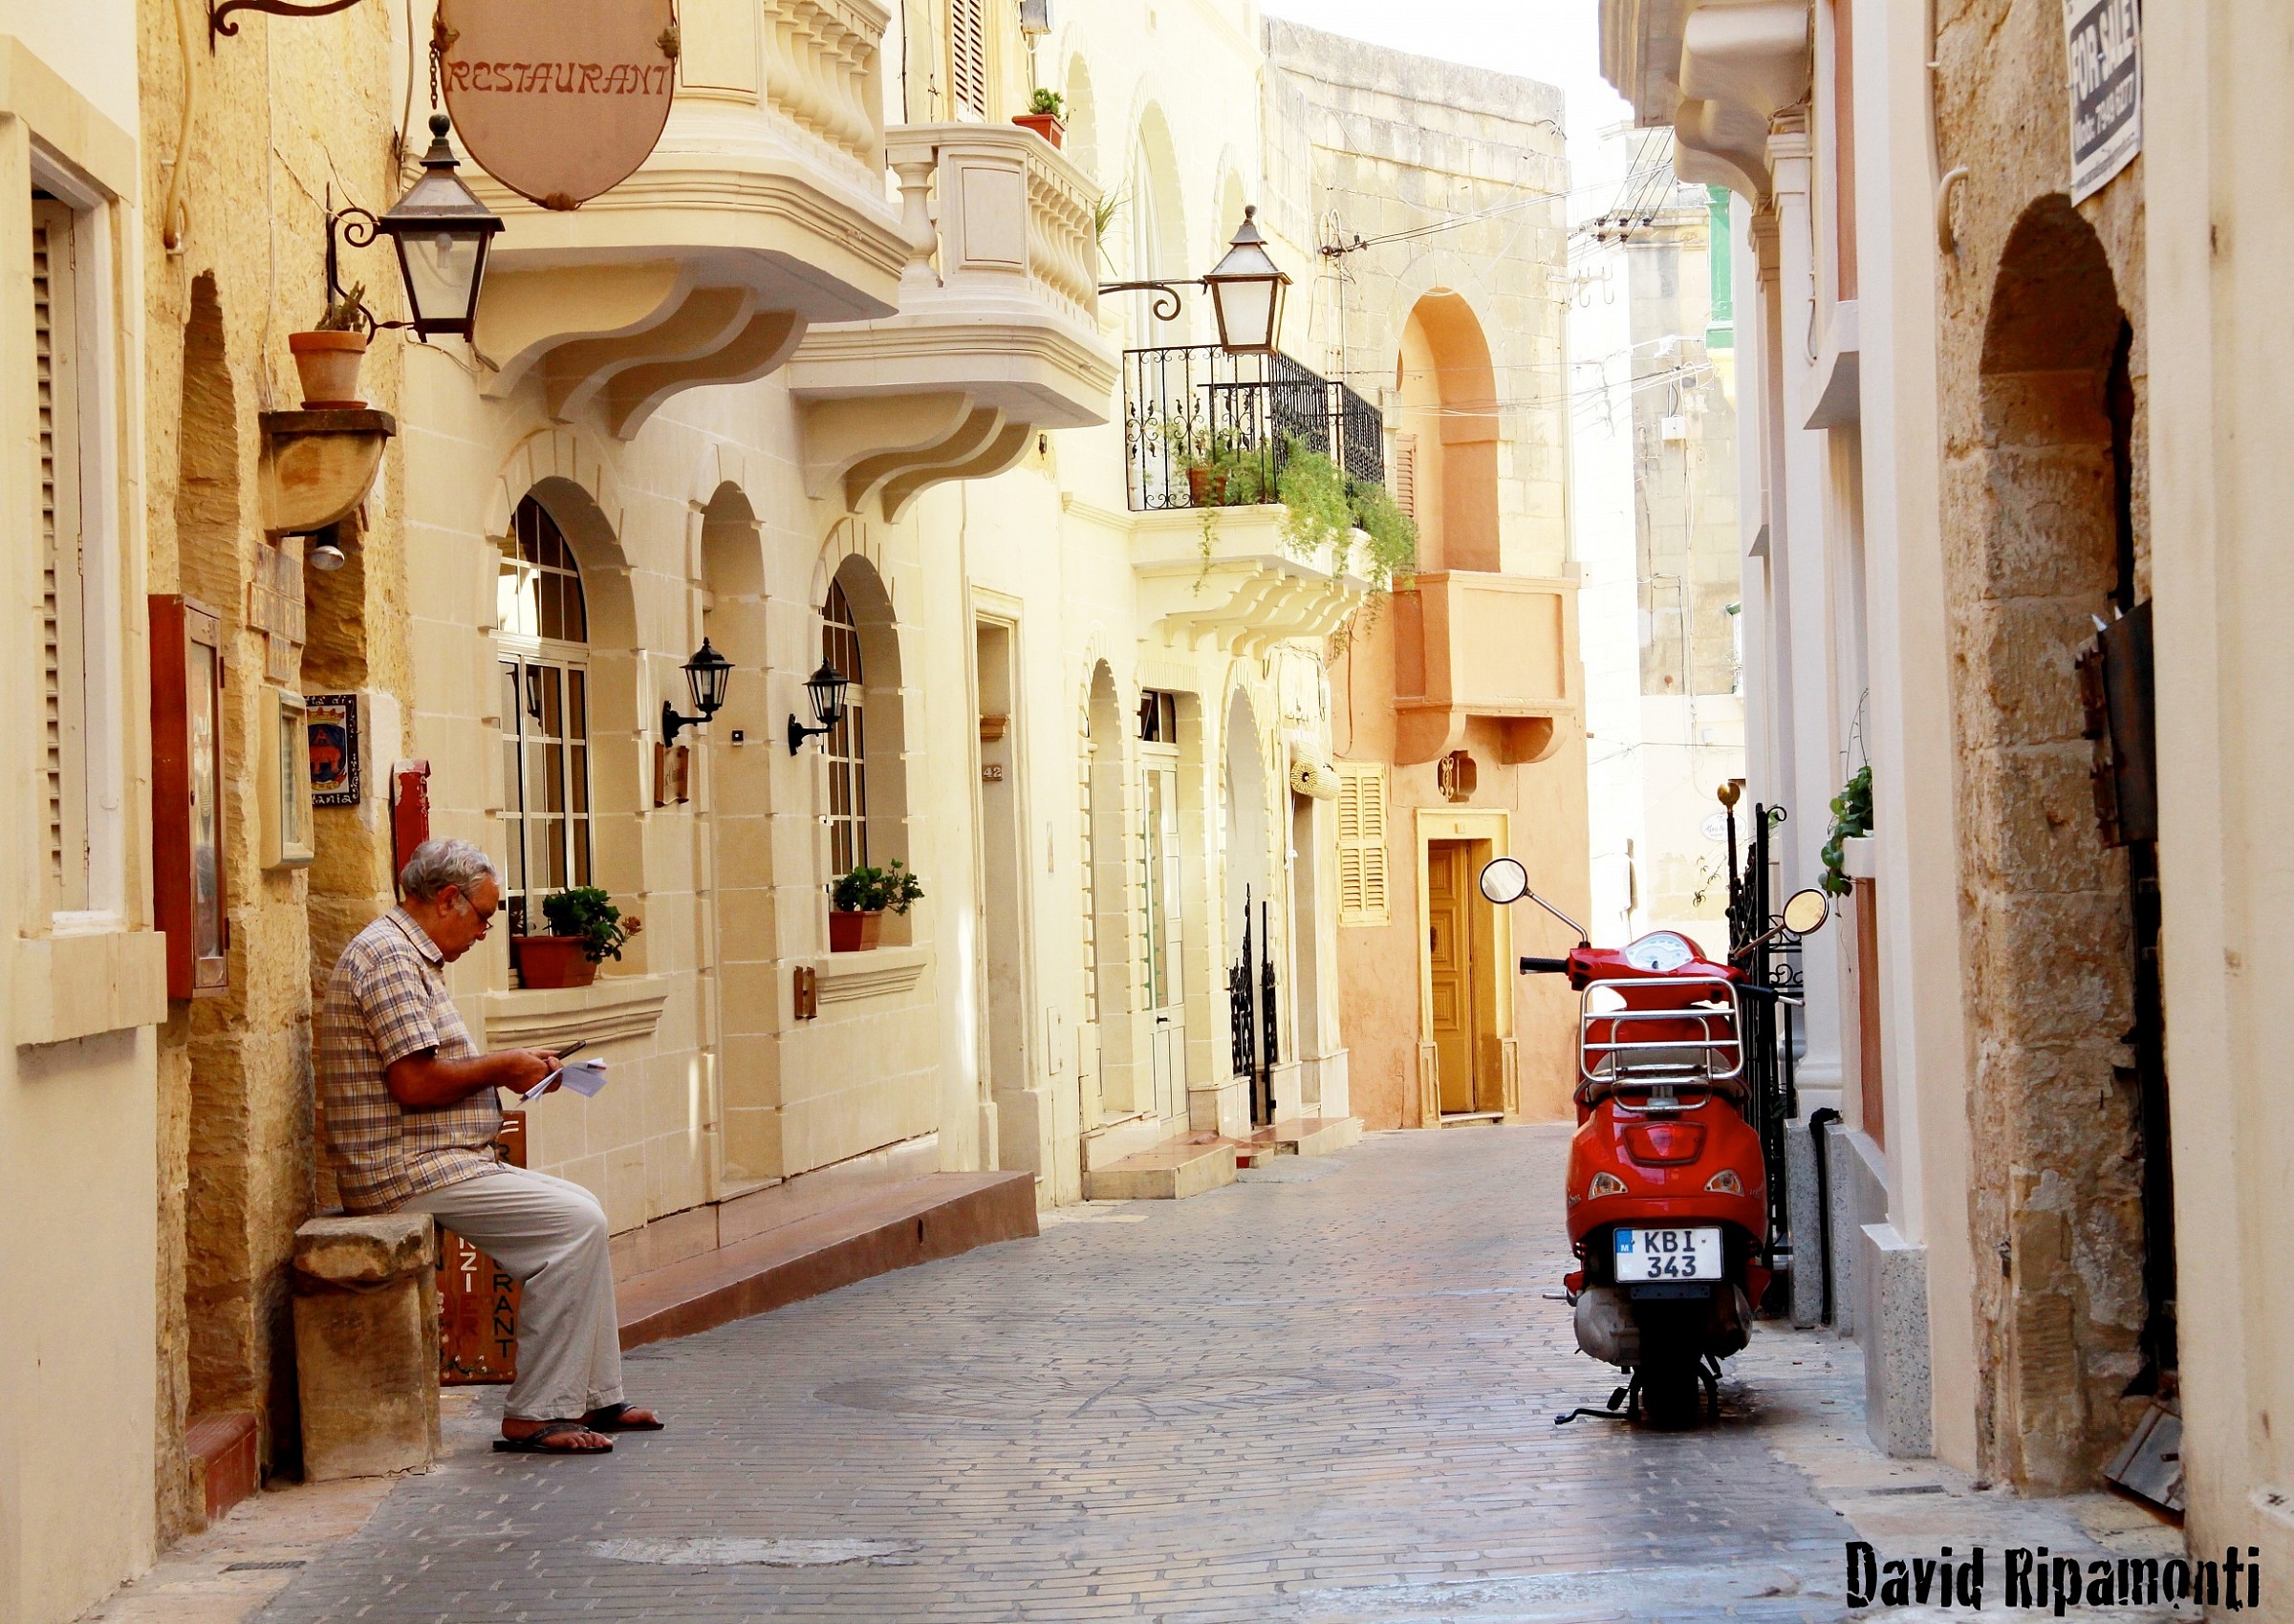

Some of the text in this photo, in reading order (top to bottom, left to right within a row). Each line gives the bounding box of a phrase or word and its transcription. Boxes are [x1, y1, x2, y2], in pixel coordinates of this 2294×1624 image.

[2070, 0, 2134, 107] FOR SALE
[444, 60, 669, 95] RESTAURANT
[984, 767, 1002, 778] 42
[1644, 1230, 1697, 1253] KBI
[1647, 1255, 1697, 1278] 343
